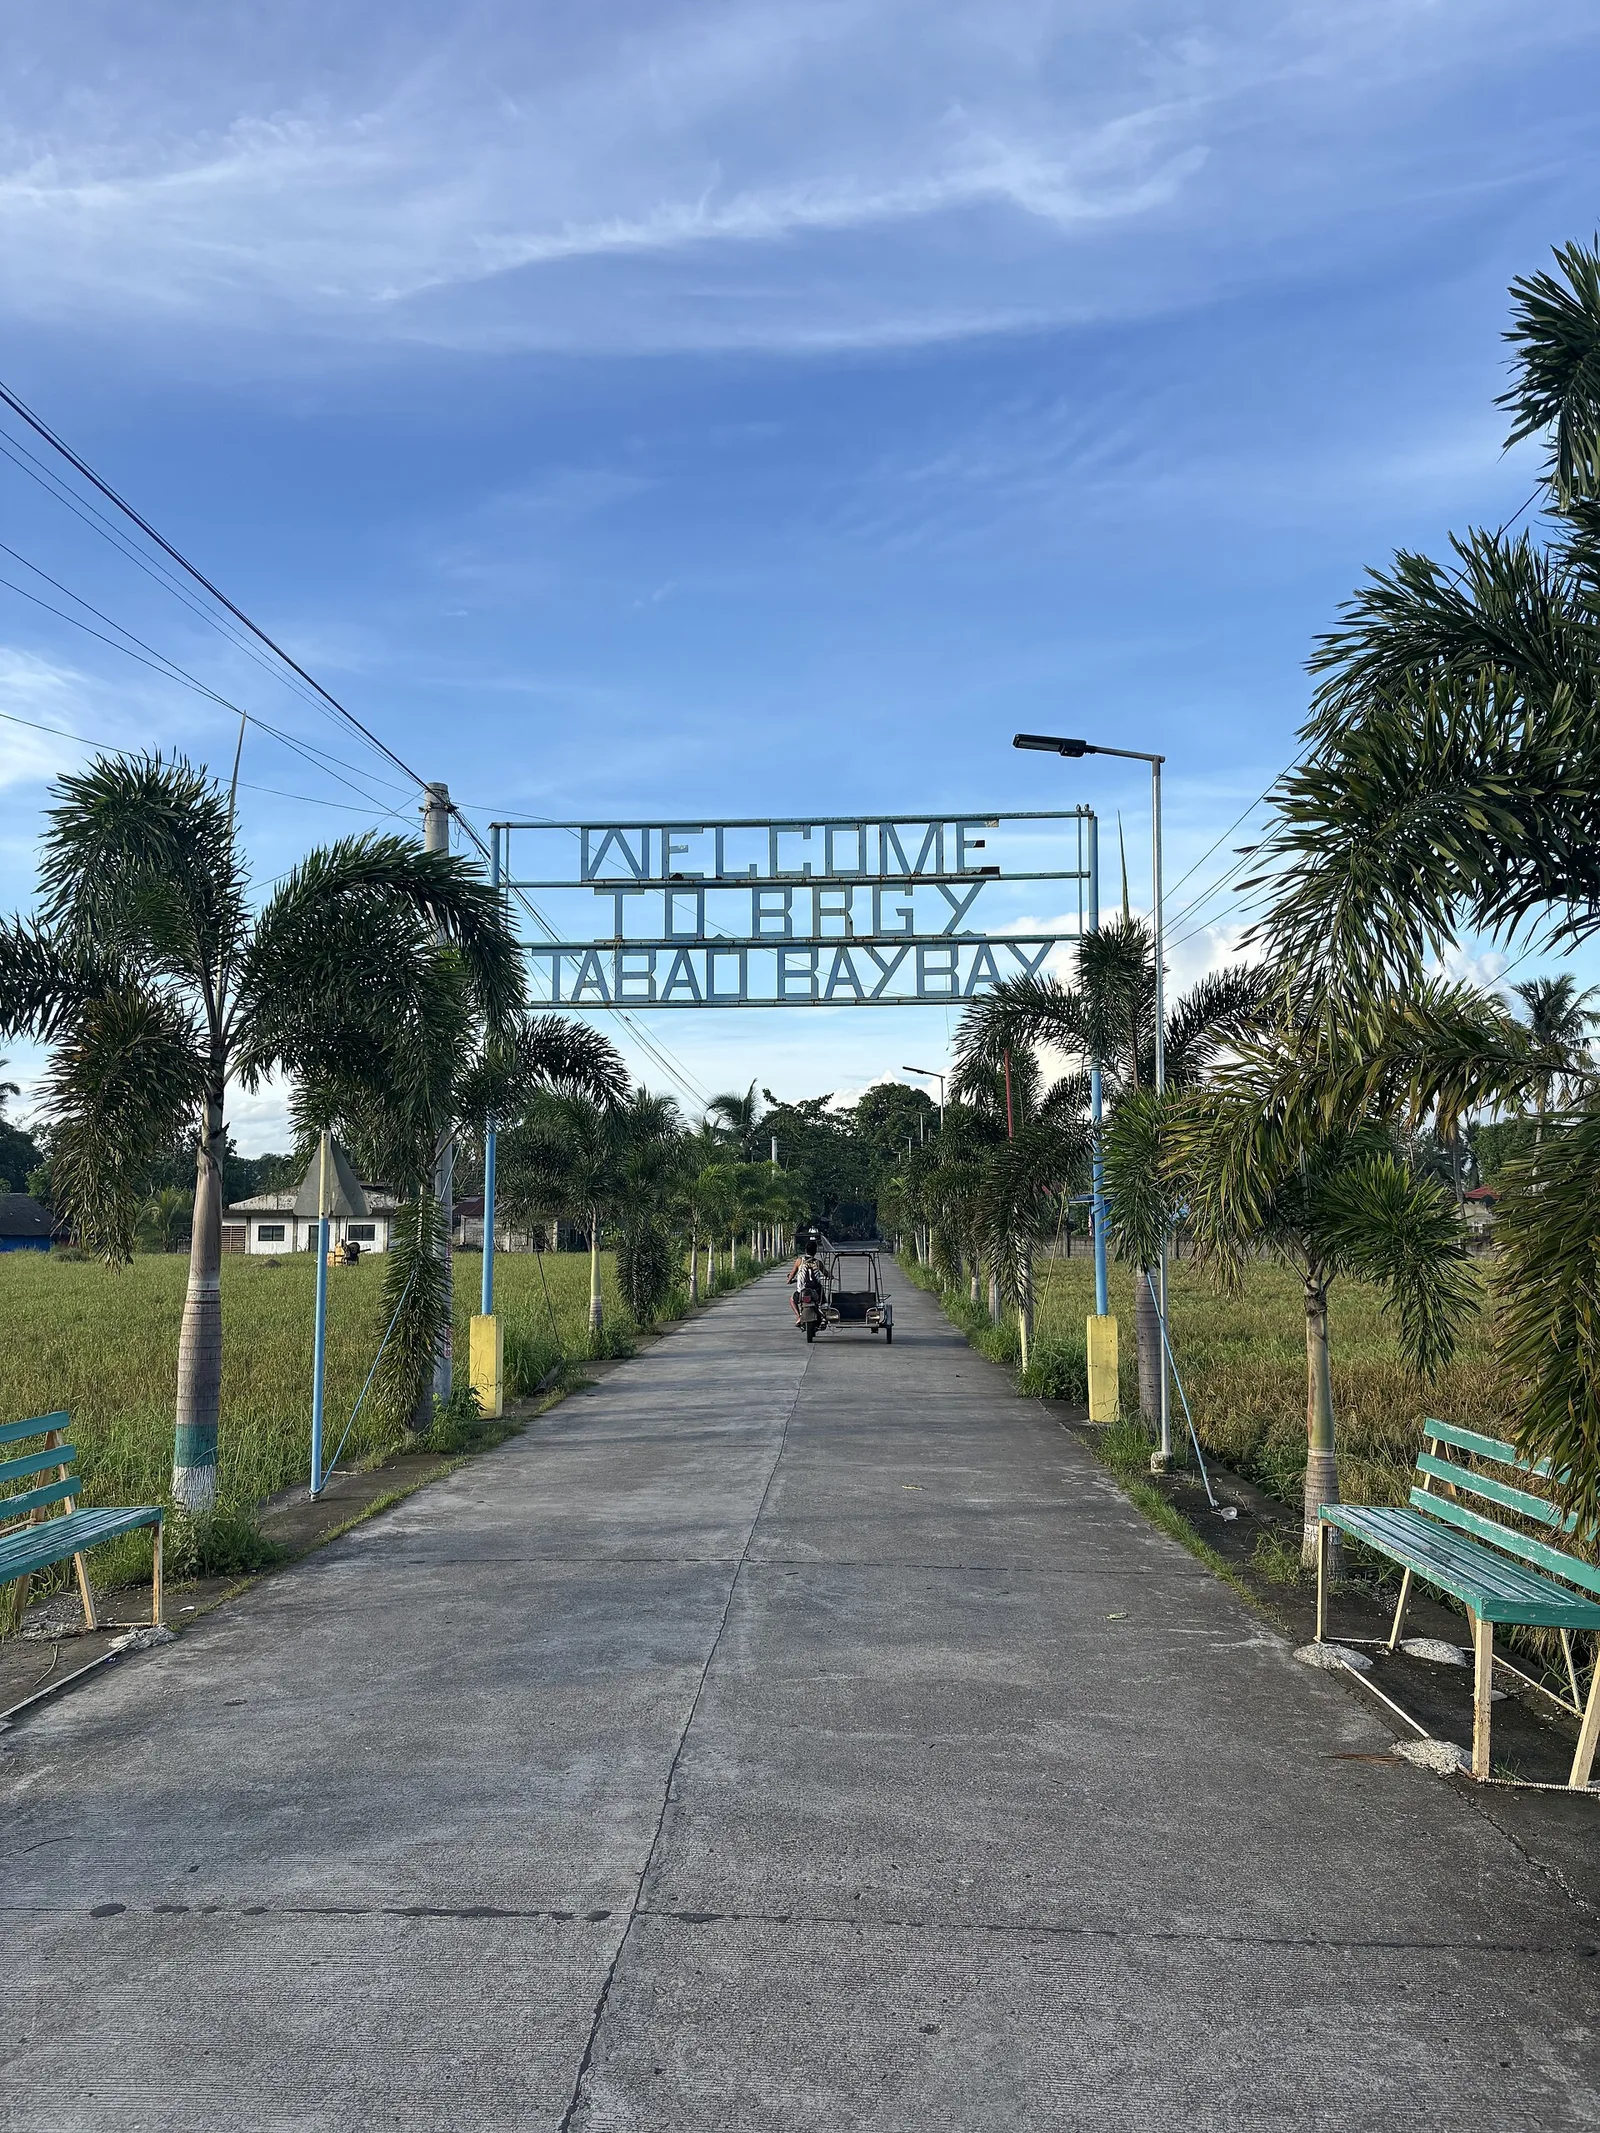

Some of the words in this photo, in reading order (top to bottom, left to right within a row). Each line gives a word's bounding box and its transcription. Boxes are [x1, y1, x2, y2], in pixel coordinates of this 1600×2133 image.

[581, 822, 1000, 880] WELCOME
[594, 886, 705, 941] TO
[752, 881, 986, 938] BRGY
[532, 948, 748, 1002] TABAO
[777, 940, 1056, 1001] BAYBAY
